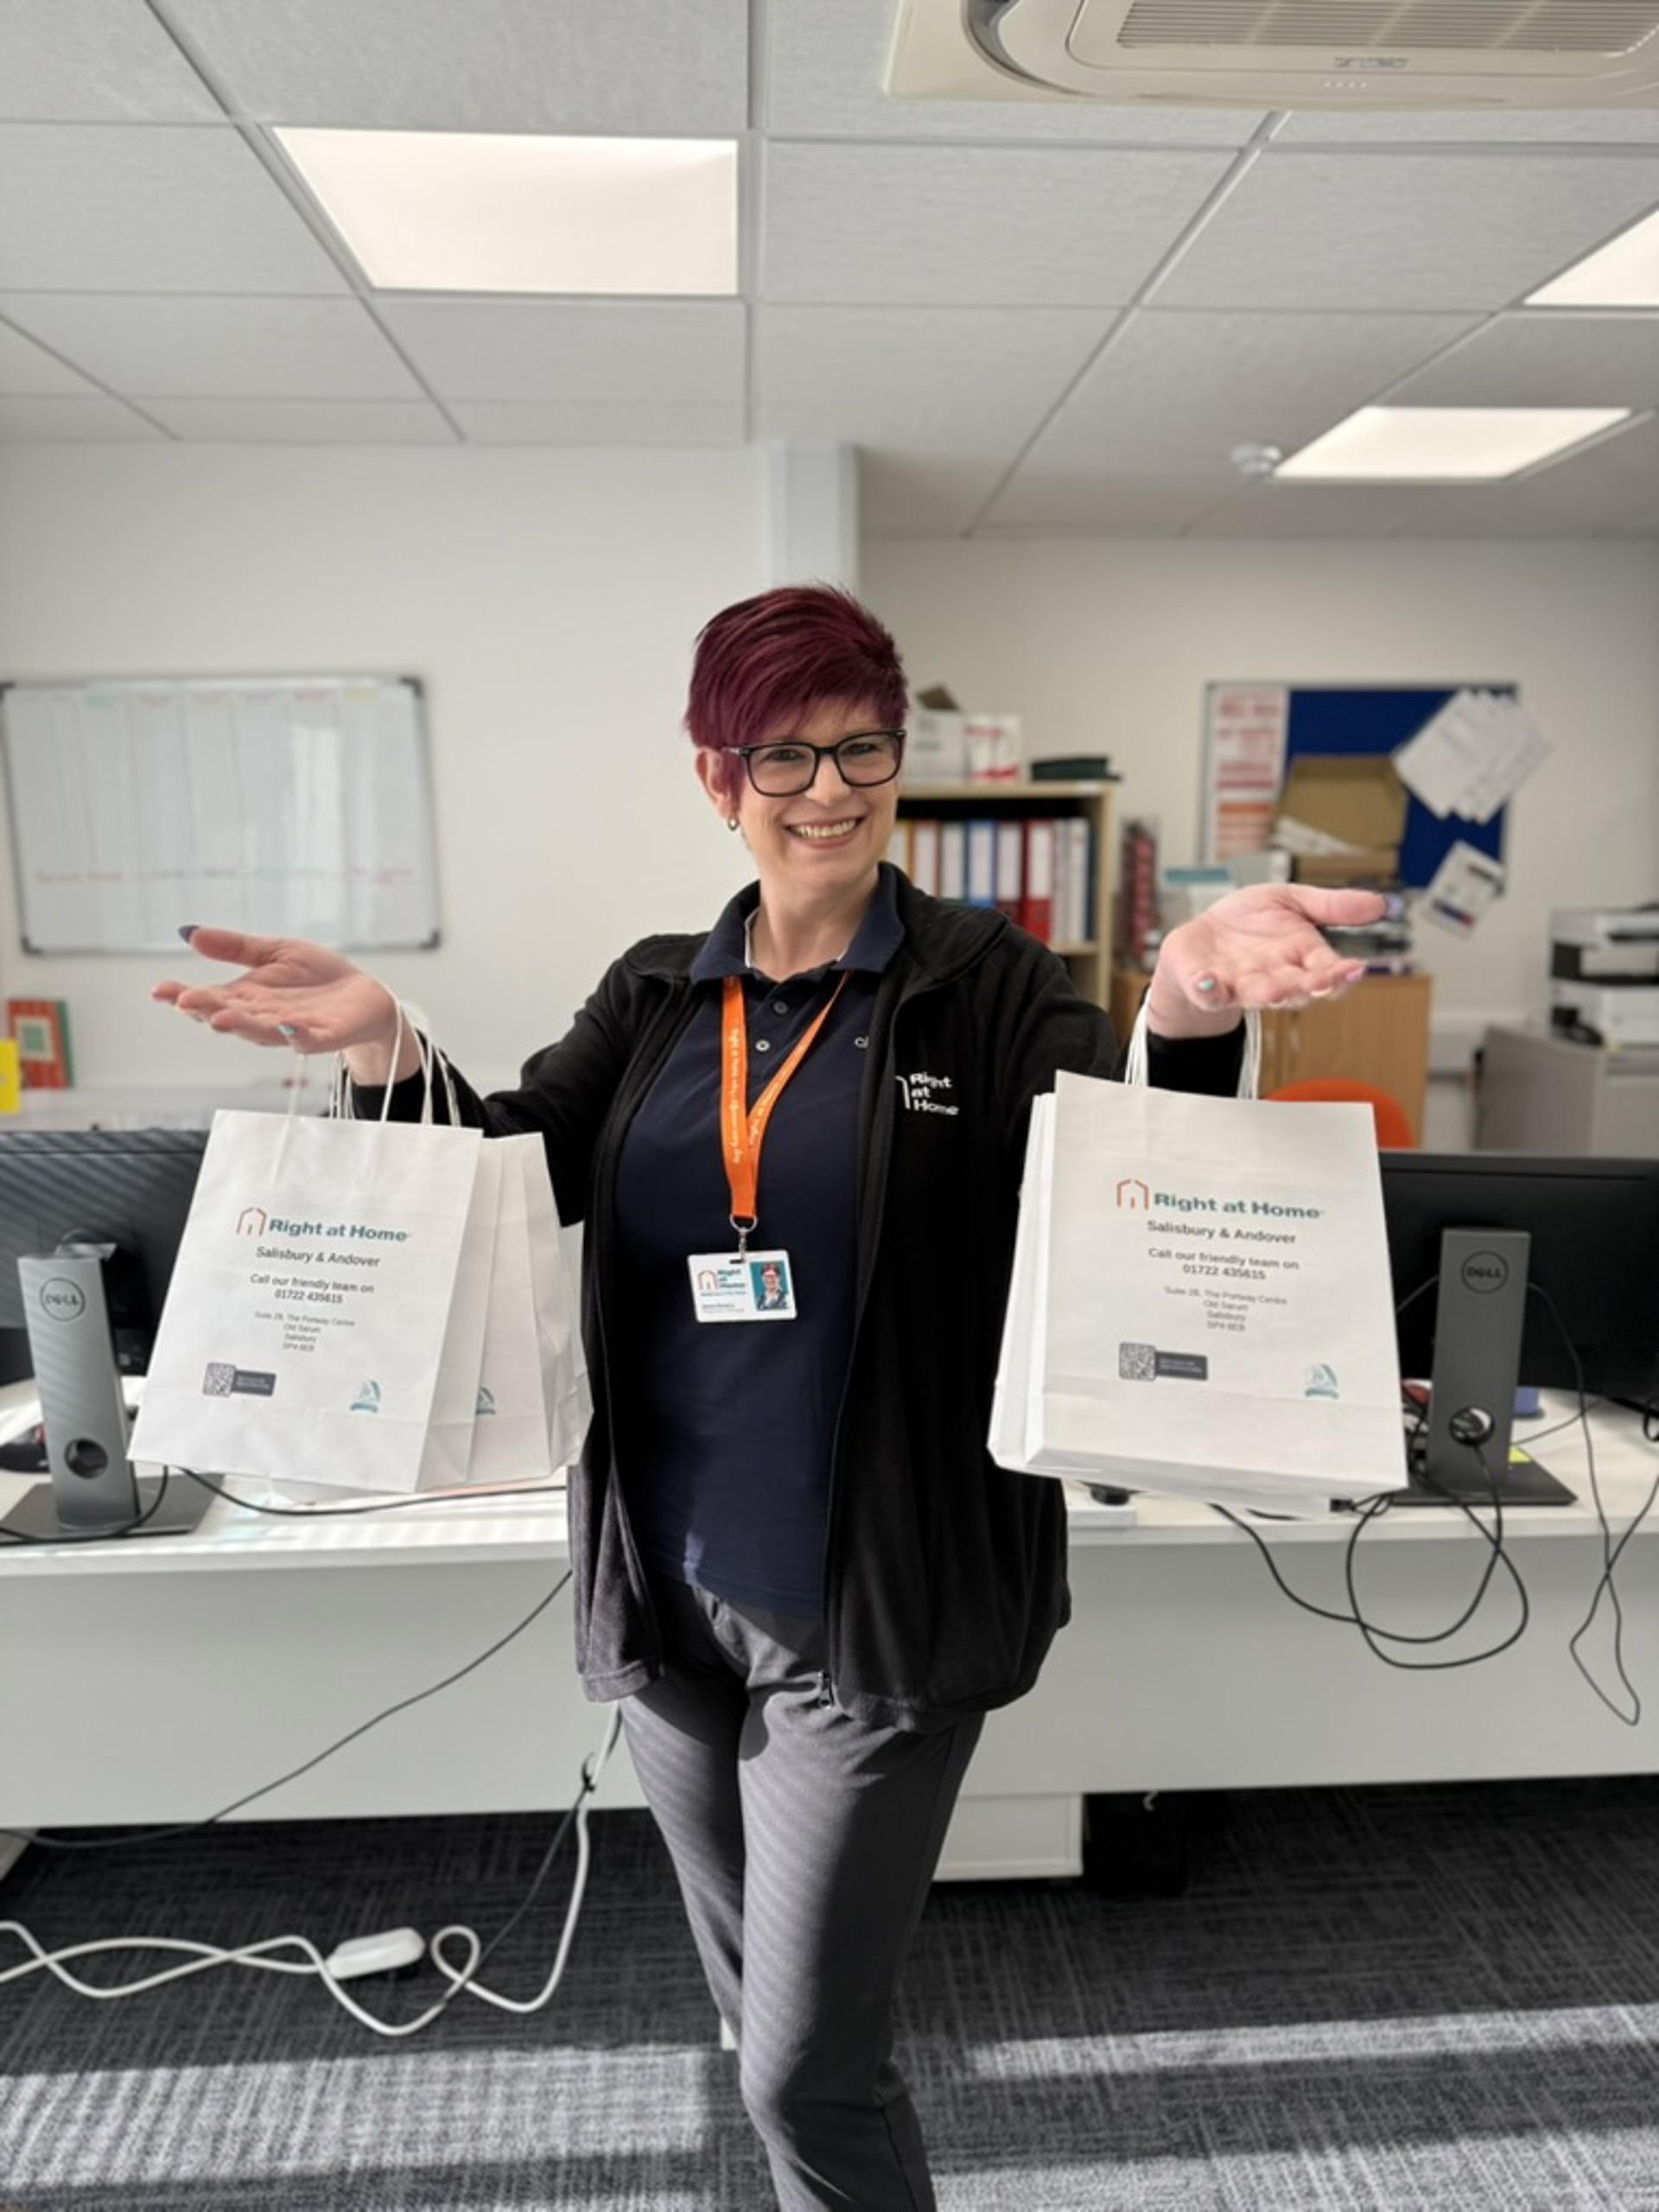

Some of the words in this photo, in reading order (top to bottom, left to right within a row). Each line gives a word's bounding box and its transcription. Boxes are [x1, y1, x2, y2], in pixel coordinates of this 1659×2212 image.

[910, 1071, 952, 1089] Right
[911, 1086, 931, 1098] at
[913, 1099, 959, 1116] Home
[1154, 1192, 1217, 1213] Right
[1224, 1200, 1247, 1213] at
[1252, 1201, 1320, 1219] Home
[269, 1218, 322, 1237] Right
[326, 1224, 346, 1236] at
[349, 1225, 407, 1243] Home
[1147, 1220, 1215, 1239] Salisbury
[1219, 1229, 1230, 1239] &
[1234, 1229, 1296, 1243] Andover
[257, 1246, 314, 1263] Salisbury
[315, 1253, 325, 1262] &
[327, 1252, 380, 1267] Andover
[1148, 1248, 1172, 1259] Call
[1175, 1252, 1196, 1261] our
[1199, 1252, 1246, 1267] friendly
[1249, 1257, 1280, 1268] team
[1282, 1261, 1300, 1270] on
[1183, 1263, 1219, 1276] 01722
[1466, 1266, 1501, 1279] DELL
[251, 1274, 270, 1283] Call
[272, 1277, 289, 1286] our
[291, 1276, 329, 1291] friendly
[332, 1281, 358, 1292] team
[45, 1294, 79, 1306] DELL
[275, 1289, 305, 1300] 01722
